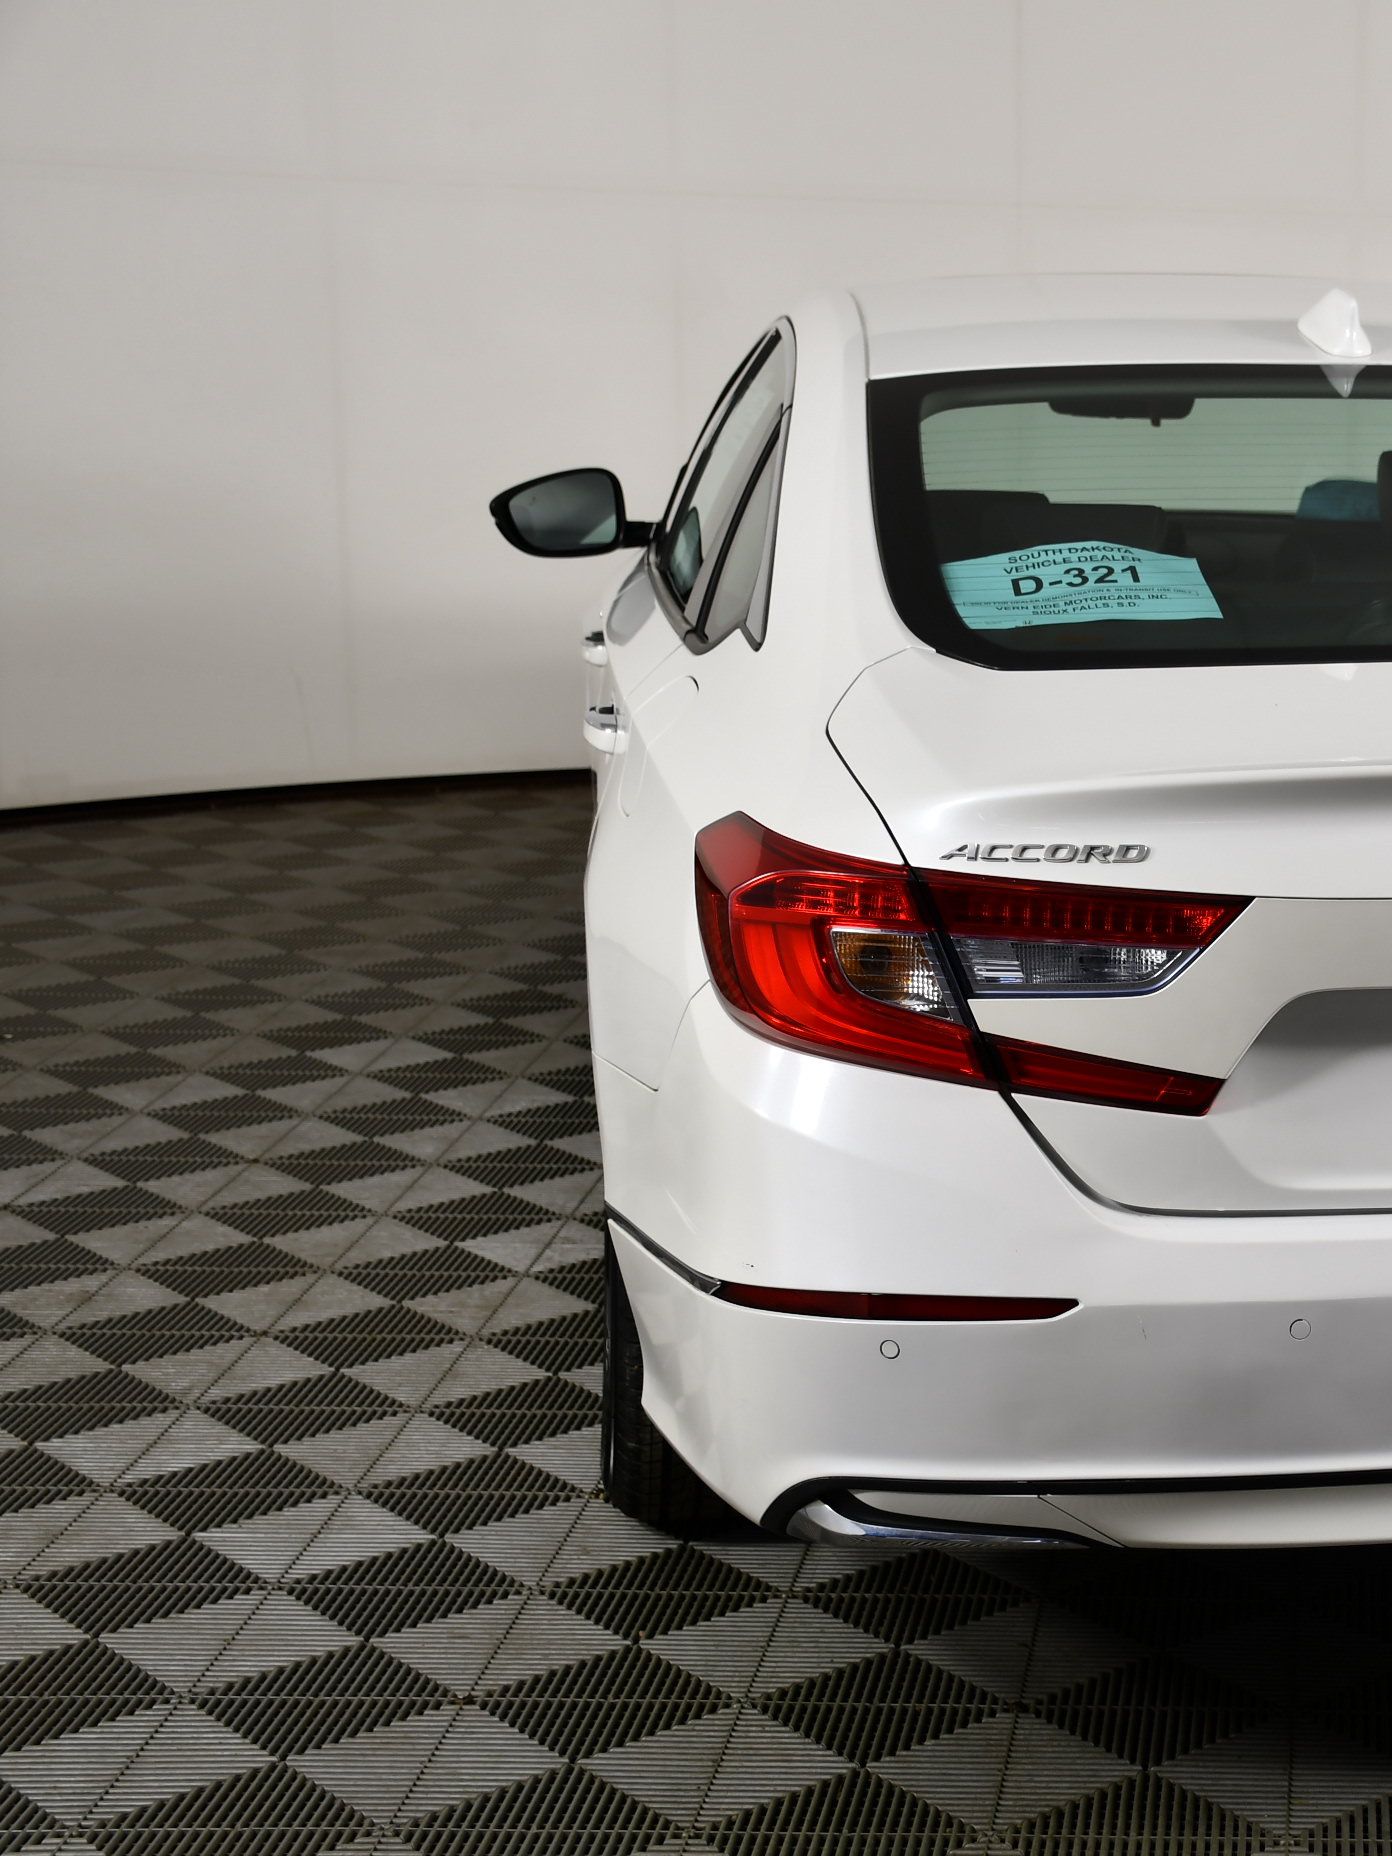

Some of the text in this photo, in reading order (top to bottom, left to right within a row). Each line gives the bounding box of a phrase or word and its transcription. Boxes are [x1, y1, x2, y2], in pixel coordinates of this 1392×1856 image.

[1003, 554, 1143, 575] VEHICLE DEALER
[1008, 545, 1135, 564] SOUTH DAKOTA
[1010, 565, 1141, 597] D-321
[1031, 608, 1070, 616] SIOUX
[1073, 601, 1114, 612] FALLS,
[1032, 603, 1061, 611] EIDE
[1064, 593, 1145, 607] MOTORCARS,
[939, 843, 1151, 864] ACCORD
